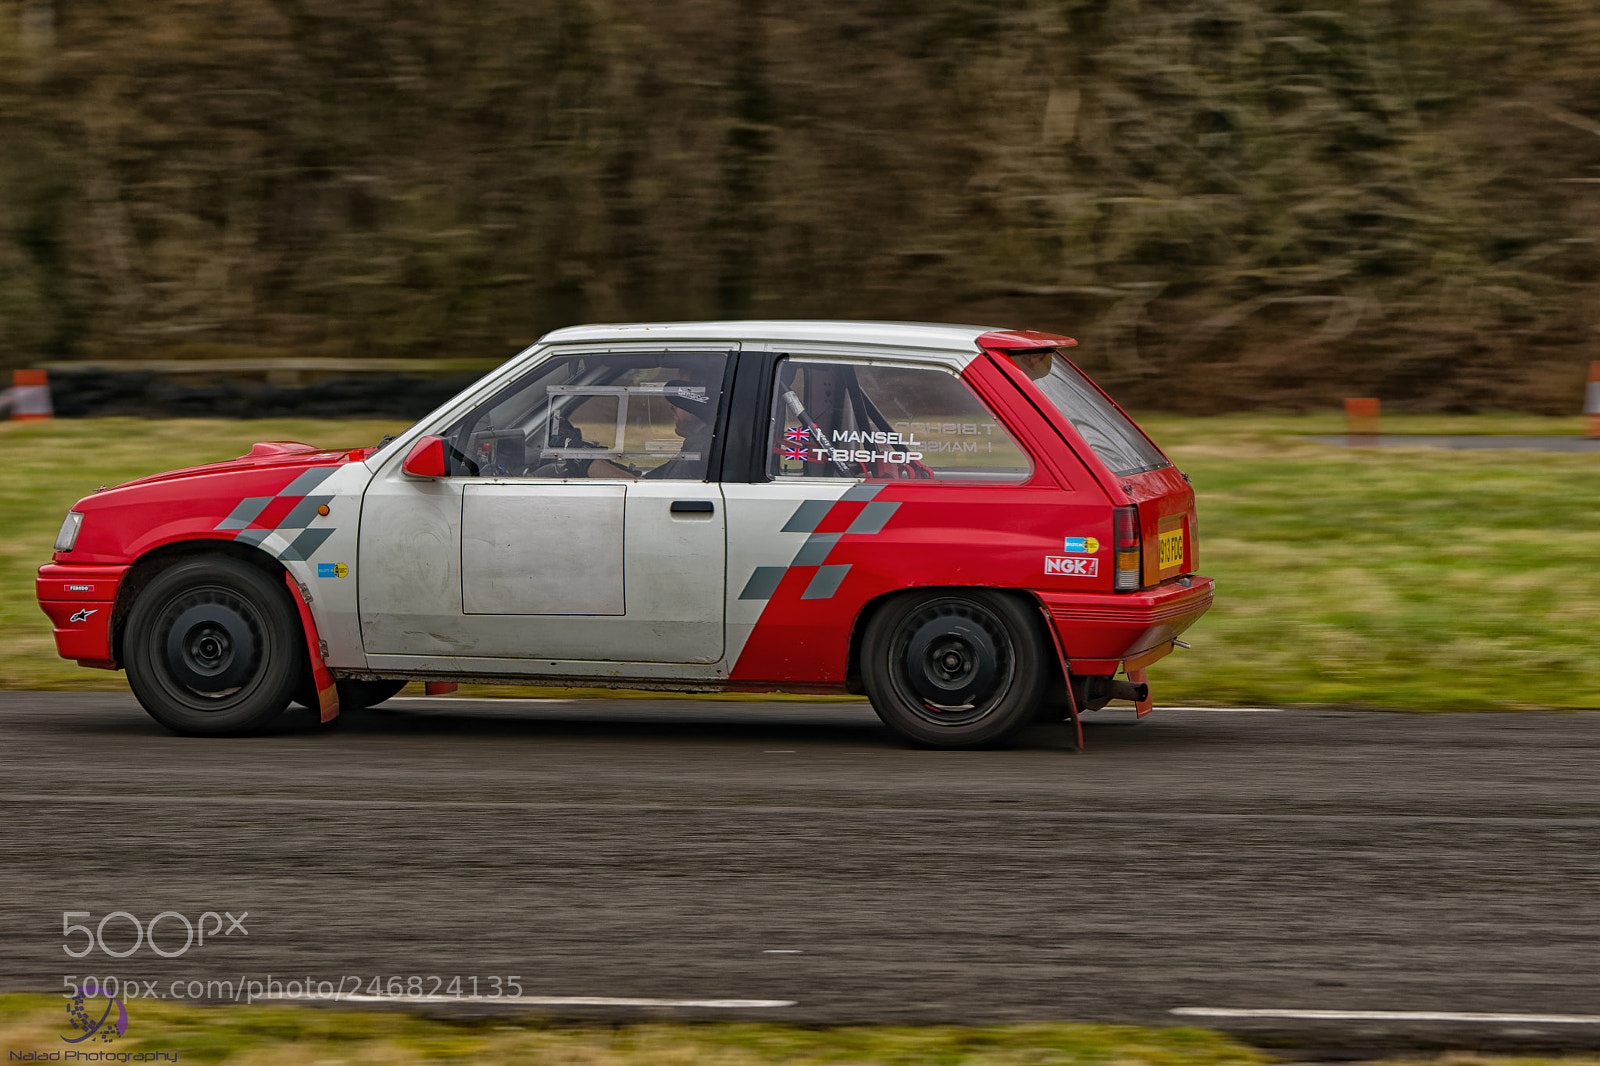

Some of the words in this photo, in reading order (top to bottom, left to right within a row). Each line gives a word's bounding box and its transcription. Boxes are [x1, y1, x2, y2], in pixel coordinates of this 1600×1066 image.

[832, 429, 921, 446] MANSELL
[812, 448, 924, 464] T.BISHOP
[1047, 558, 1087, 575] NGK
